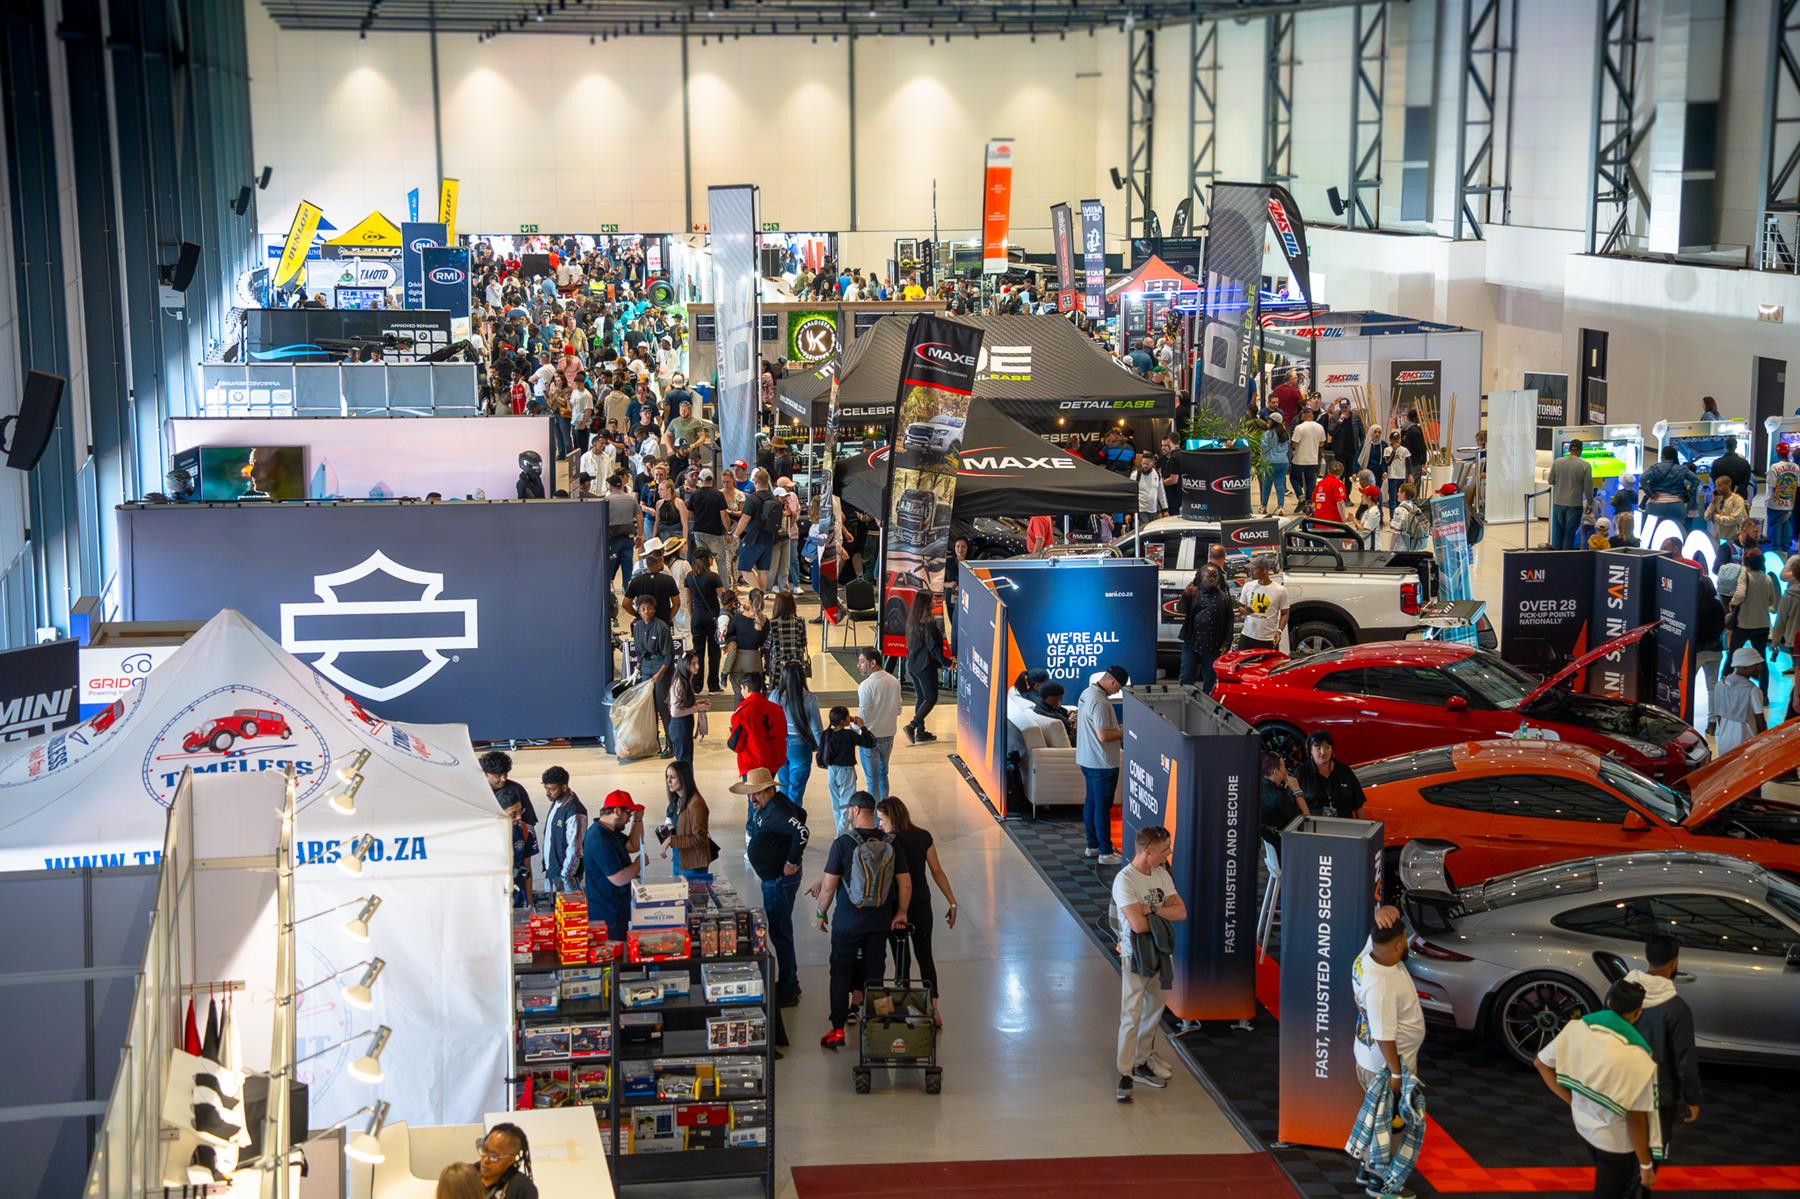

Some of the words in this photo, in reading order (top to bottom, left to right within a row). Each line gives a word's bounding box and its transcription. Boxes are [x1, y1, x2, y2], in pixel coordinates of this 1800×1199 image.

[288, 208, 309, 261] DUNLOP
[1267, 198, 1301, 258] AMSOIL
[1239, 284, 1257, 387] DETAILEASE
[1295, 326, 1344, 338] AMSOIL
[928, 347, 976, 366] MAXE
[1325, 374, 1359, 383] AMSOIL
[1395, 370, 1435, 381] AMSOIL
[1059, 400, 1155, 410] DETAILEASE
[963, 456, 1076, 470] MAXE
[1222, 478, 1250, 488] MAXE
[1442, 508, 1460, 518] MAXE
[1240, 530, 1269, 540] MAXE
[1520, 570, 1545, 580] SANI
[1608, 565, 1625, 610] SANI
[1520, 600, 1557, 611] OVER
[1560, 600, 1577, 611] 28
[1093, 631, 1120, 643] ALL
[1047, 644, 1103, 656] GEARED
[1047, 656, 1067, 668] UP
[1070, 655, 1097, 667] FOR
[1047, 668, 1080, 680] YOU!
[0, 688, 73, 727] MINI
[1129, 760, 1146, 784] COME
[1145, 770, 1154, 792] IN!
[1129, 778, 1139, 798] WE
[1138, 784, 1158, 815] MISSED
[1228, 775, 1239, 826] SECURE
[1227, 827, 1238, 857] AND
[1225, 859, 1237, 920] TRUSTED
[1318, 855, 1332, 919] SECURE
[1225, 922, 1236, 954] FAST,
[1317, 921, 1331, 958] AND
[1316, 961, 1330, 1036] TRUSTED
[1315, 1037, 1329, 1079] FAST,
